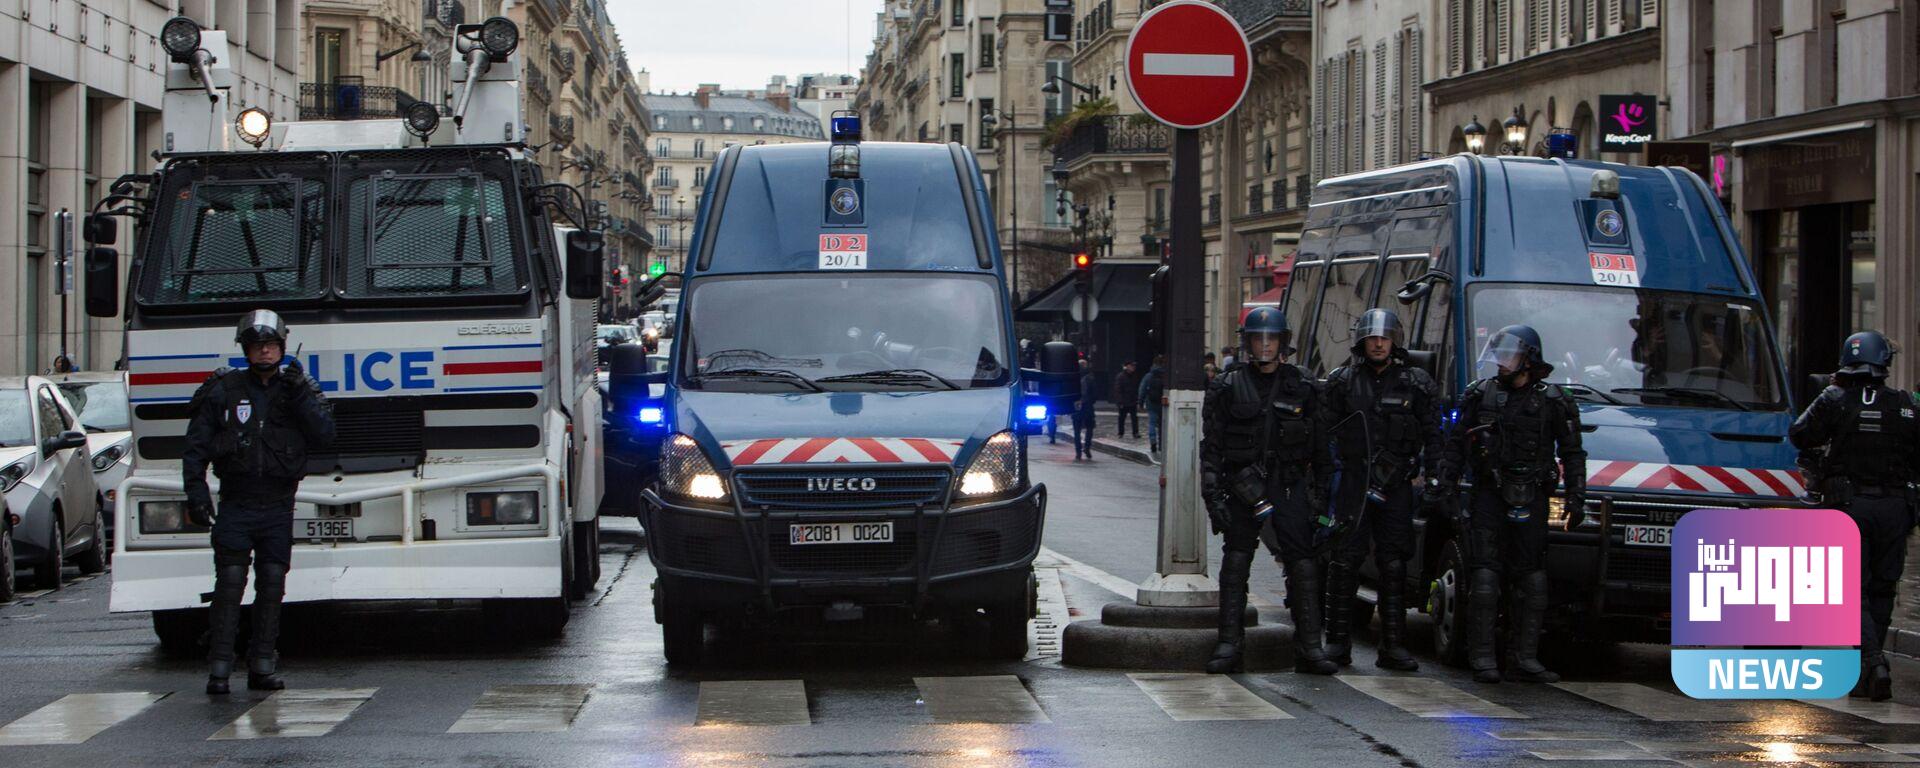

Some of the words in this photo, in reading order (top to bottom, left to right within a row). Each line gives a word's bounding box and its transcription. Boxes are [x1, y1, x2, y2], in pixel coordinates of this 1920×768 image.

[824, 236, 841, 250] D
[848, 236, 861, 250] 2
[825, 253, 860, 267] 20/1
[1593, 254, 1610, 267] D
[1617, 256, 1628, 269] 1
[1598, 272, 1633, 284] 20/1
[458, 323, 532, 335] SOFRAME
[228, 351, 434, 391] LICE
[807, 478, 876, 491] IVECO
[307, 521, 349, 536] 5136E
[805, 525, 840, 541] 2081
[853, 524, 890, 541] 0020
